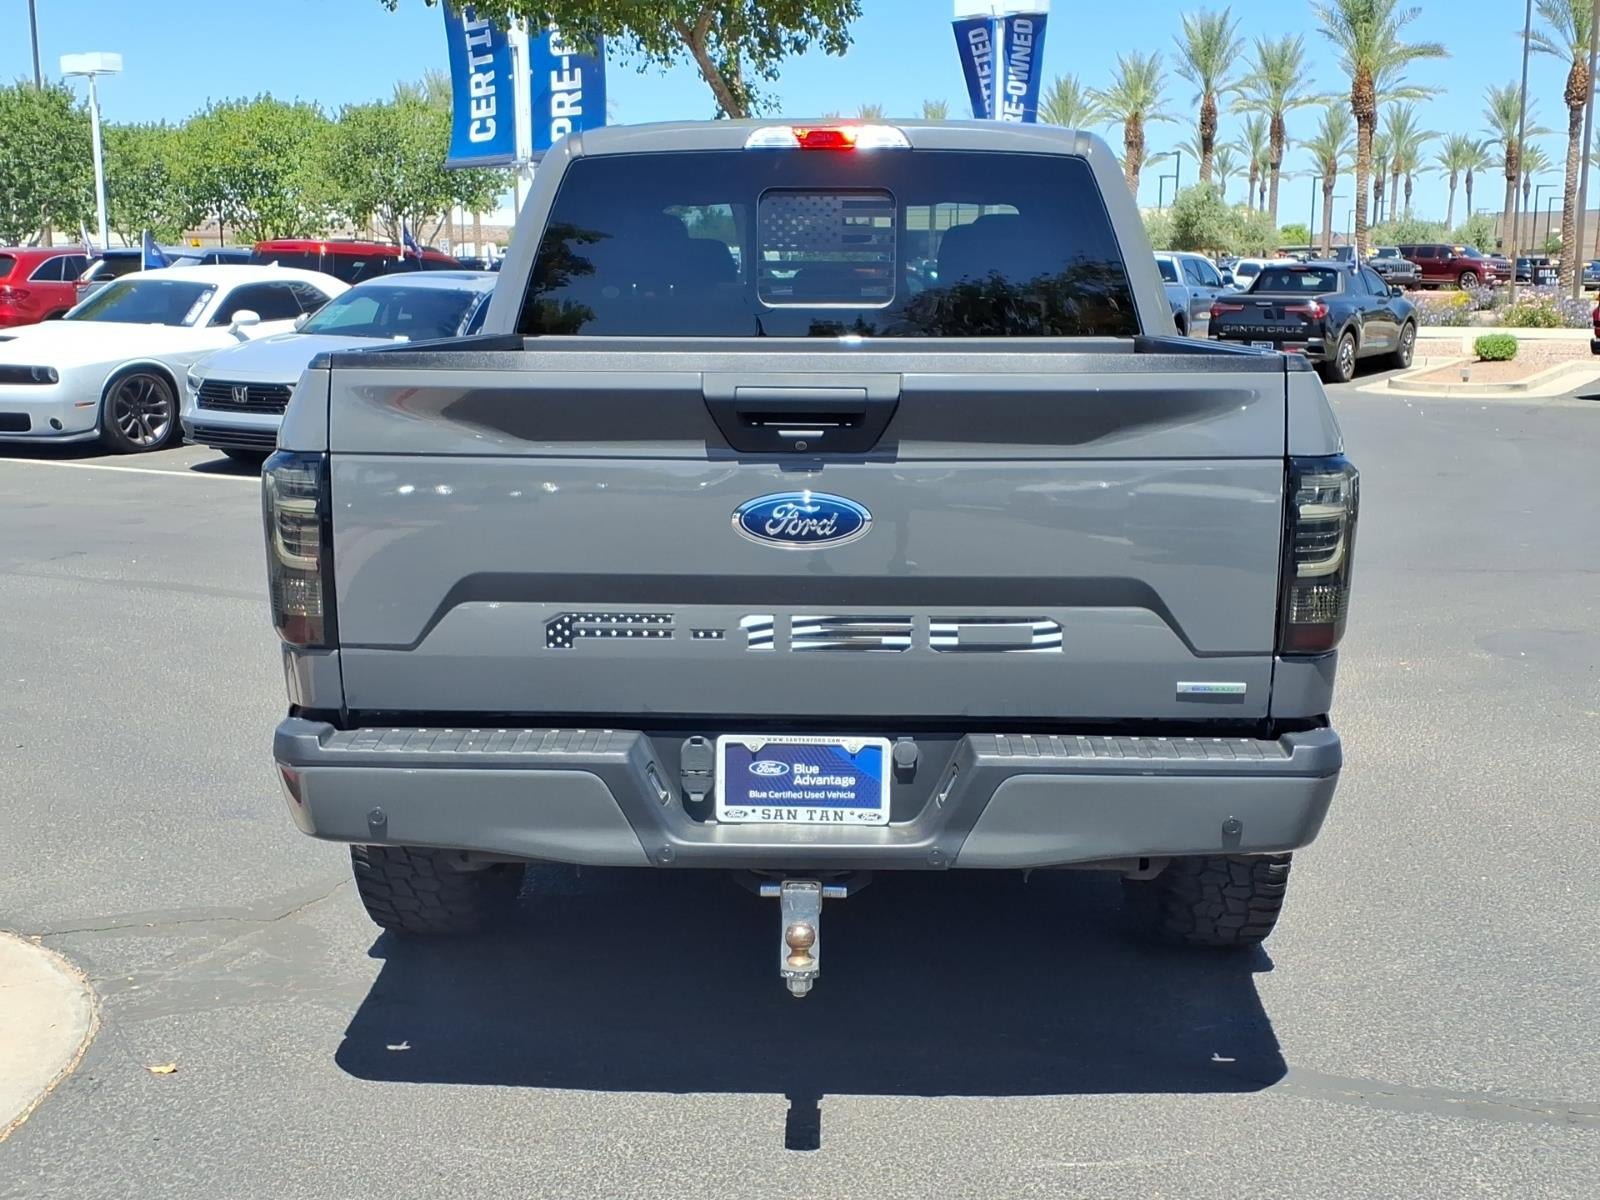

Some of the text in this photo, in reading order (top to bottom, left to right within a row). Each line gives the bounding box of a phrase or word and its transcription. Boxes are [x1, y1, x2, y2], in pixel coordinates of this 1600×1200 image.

[1222, 324, 1304, 334] SANTA CRUZ
[764, 502, 839, 536] Ford
[544, 612, 1063, 654] F-150
[756, 763, 782, 773] Ford
[793, 763, 820, 774] Blue
[793, 775, 856, 787] Advantage
[748, 790, 856, 799] Blue Certified Used Vehicle
[761, 808, 798, 820] SAN
[806, 809, 844, 821] TAN
